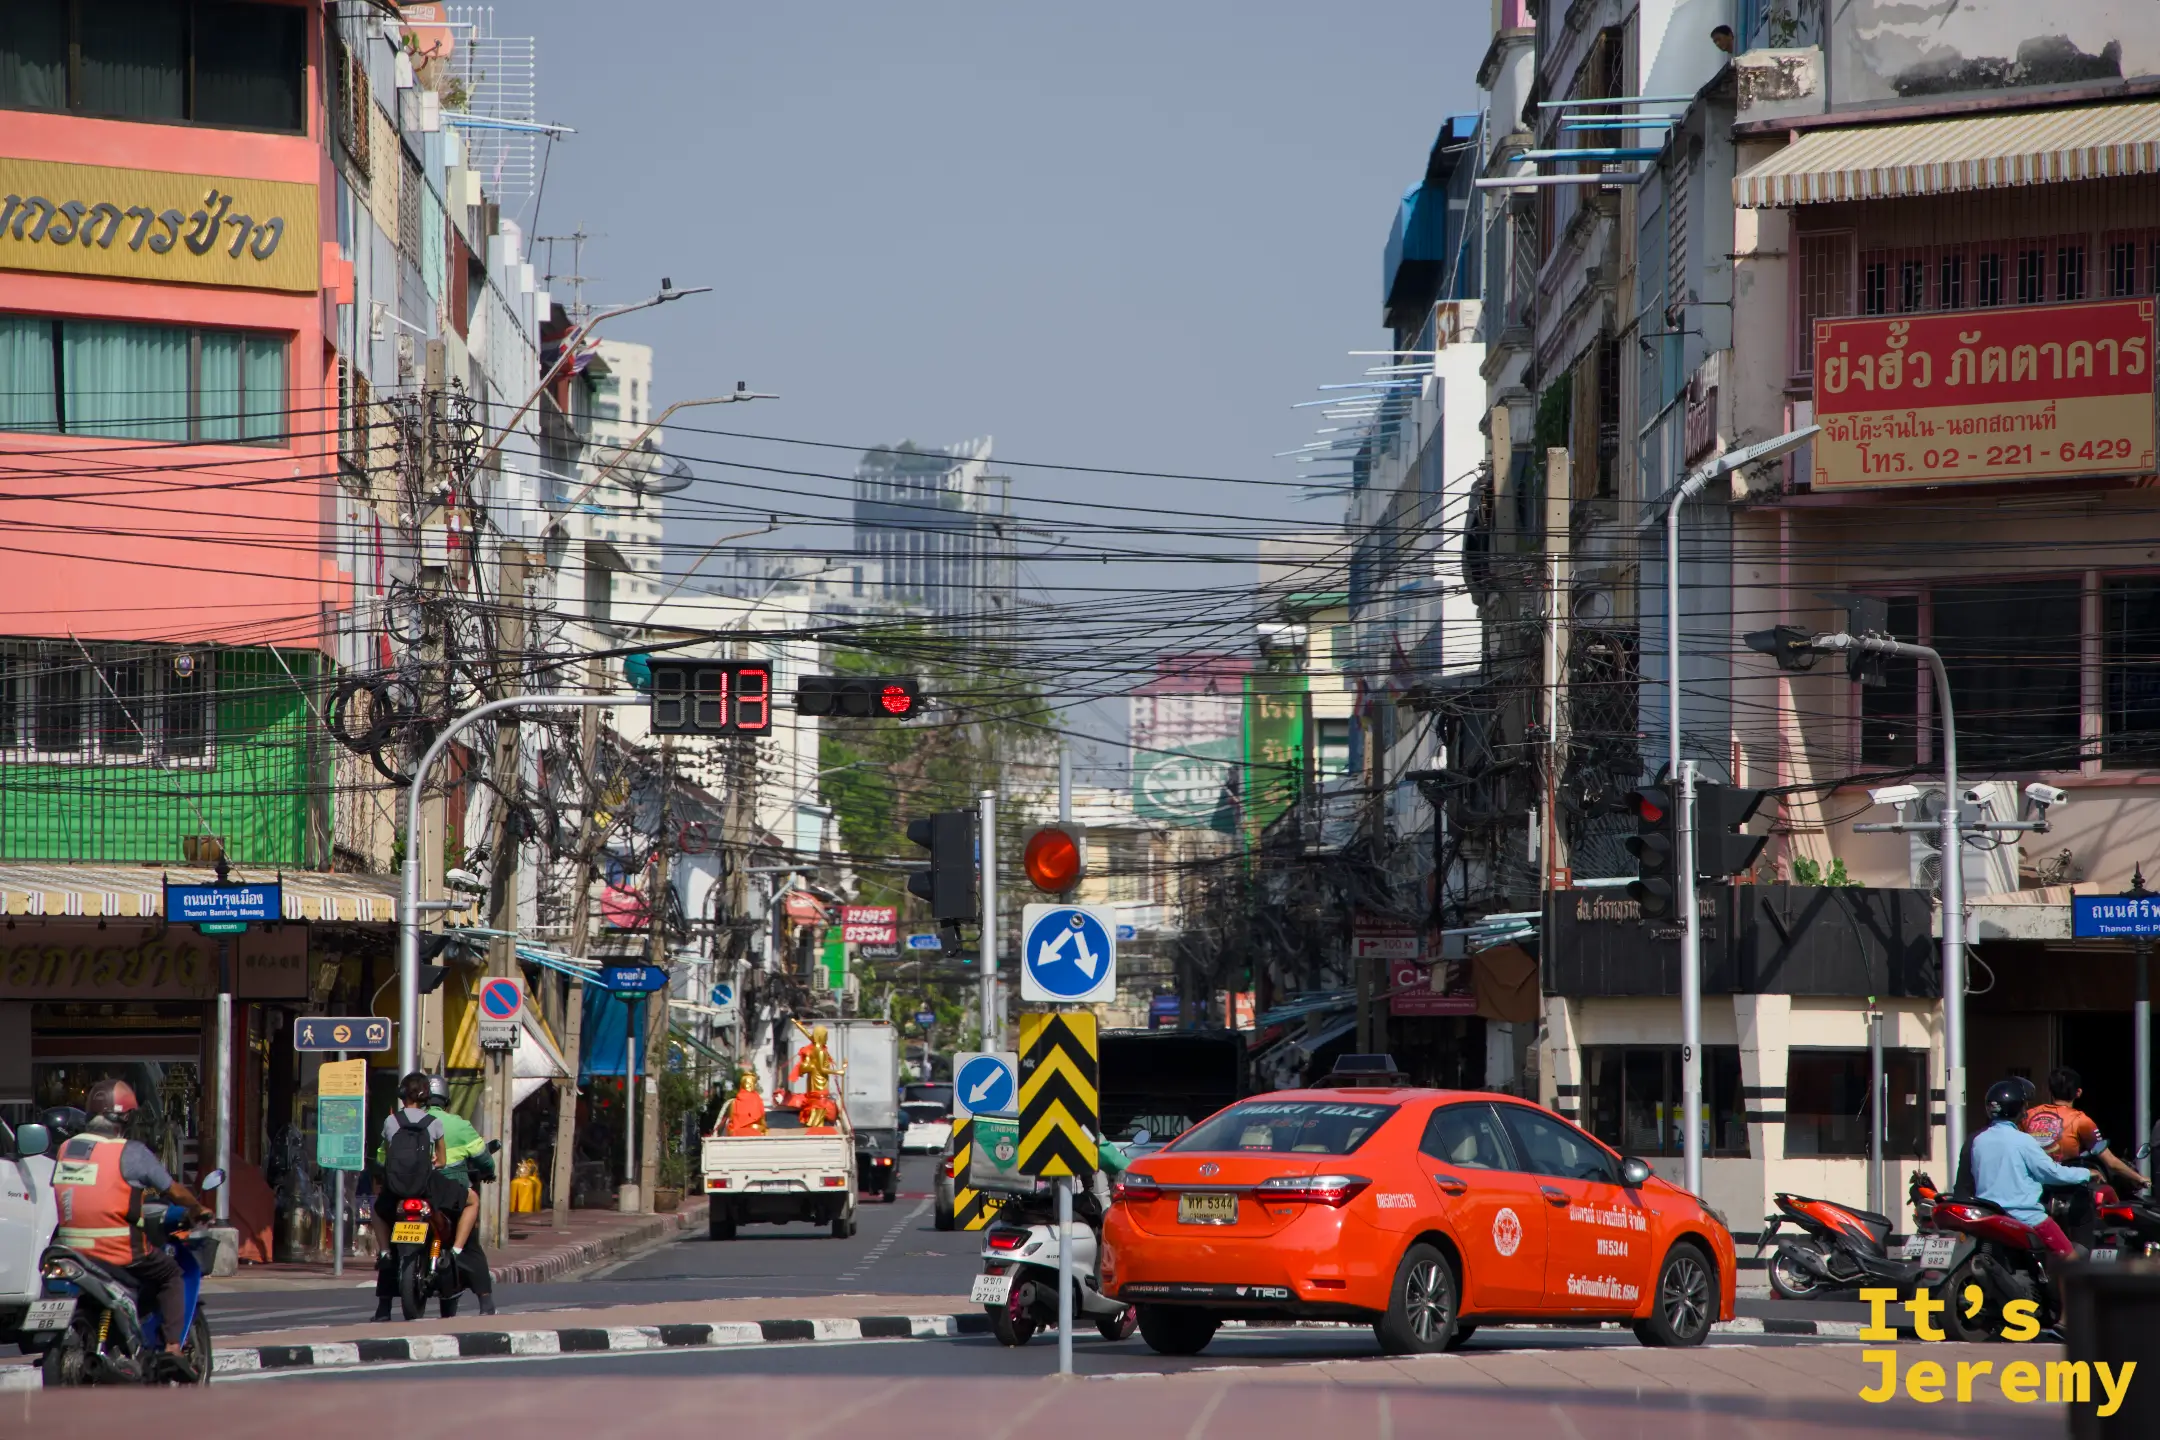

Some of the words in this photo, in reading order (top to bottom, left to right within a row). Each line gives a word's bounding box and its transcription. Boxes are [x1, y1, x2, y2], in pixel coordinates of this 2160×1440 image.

[1824, 321, 1932, 394] ย่งฮั้ว
[1944, 330, 2147, 387] ภัตตาคาร
[1856, 443, 1914, 474] โทร.
[183, 889, 264, 909] ถนนบำรุงเมือง
[184, 909, 207, 917] Thanon
[210, 909, 238, 918] Bamrung
[240, 908, 265, 917] Mueang
[2099, 925, 2132, 933] Thanon
[1383, 939, 1401, 949] 100
[0, 927, 201, 989] รการช่าง
[1683, 1046, 1691, 1062] 9
[1316, 1105, 1386, 1118] TAXI
[991, 1125, 1019, 1134] LINEMA
[1208, 1196, 1233, 1210] 5344
[1928, 1257, 1945, 1265] 982
[976, 1293, 1001, 1302] 2783
[1252, 1287, 1288, 1298] TRD
